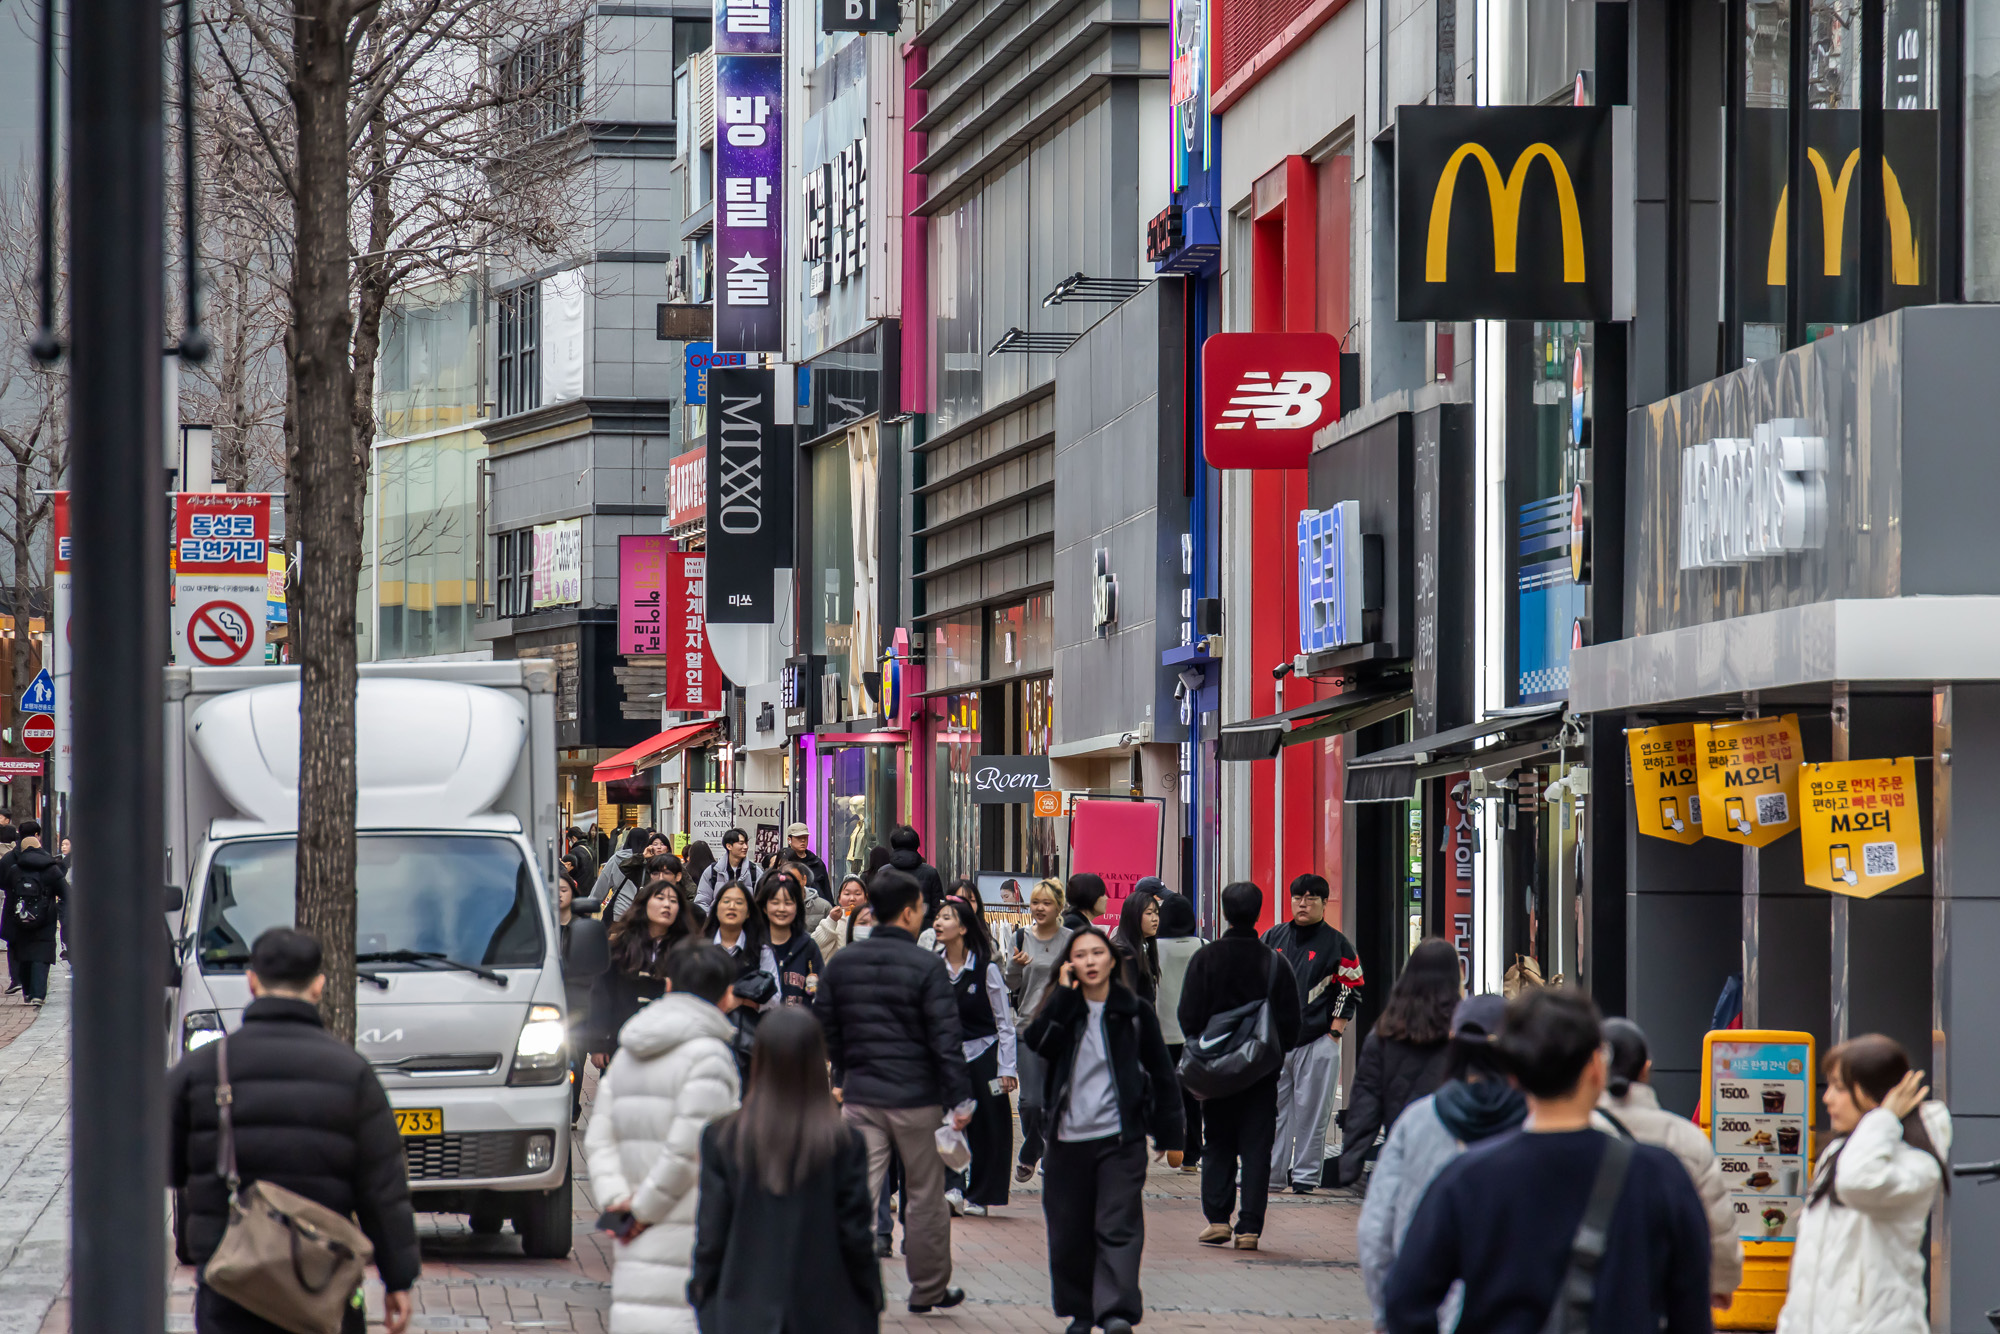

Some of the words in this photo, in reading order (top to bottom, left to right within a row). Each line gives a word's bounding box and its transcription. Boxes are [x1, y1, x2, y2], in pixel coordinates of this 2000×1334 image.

[725, 96, 772, 306] 방탈출
[720, 393, 762, 534] MIXXO
[191, 515, 254, 538] 동성로
[181, 539, 264, 562] 금연거리
[729, 594, 753, 606] 미쏘
[634, 591, 660, 653] 헤어클럽
[1641, 741, 1674, 755] 앱으로
[1707, 739, 1739, 753] 앱으로
[1742, 735, 1764, 750] 먼저
[1767, 731, 1790, 745] 주문
[1643, 756, 1676, 770] 편하고
[1708, 755, 1741, 769] 편하고
[1743, 750, 1767, 765] 빠른
[1770, 746, 1792, 761] 픽업
[975, 766, 1051, 792] Roem
[1660, 768, 1697, 787] M오
[1725, 763, 1780, 787] M오더
[1811, 780, 1848, 795] 앱으로
[1851, 778, 1875, 793] 먼저
[1878, 776, 1903, 791] 주문
[1813, 797, 1849, 812] 편하고
[1852, 795, 1877, 809] 빠른
[1880, 793, 1905, 807] 픽업
[1831, 810, 1890, 833] M오더
[1099, 872, 1142, 880] EARANCE
